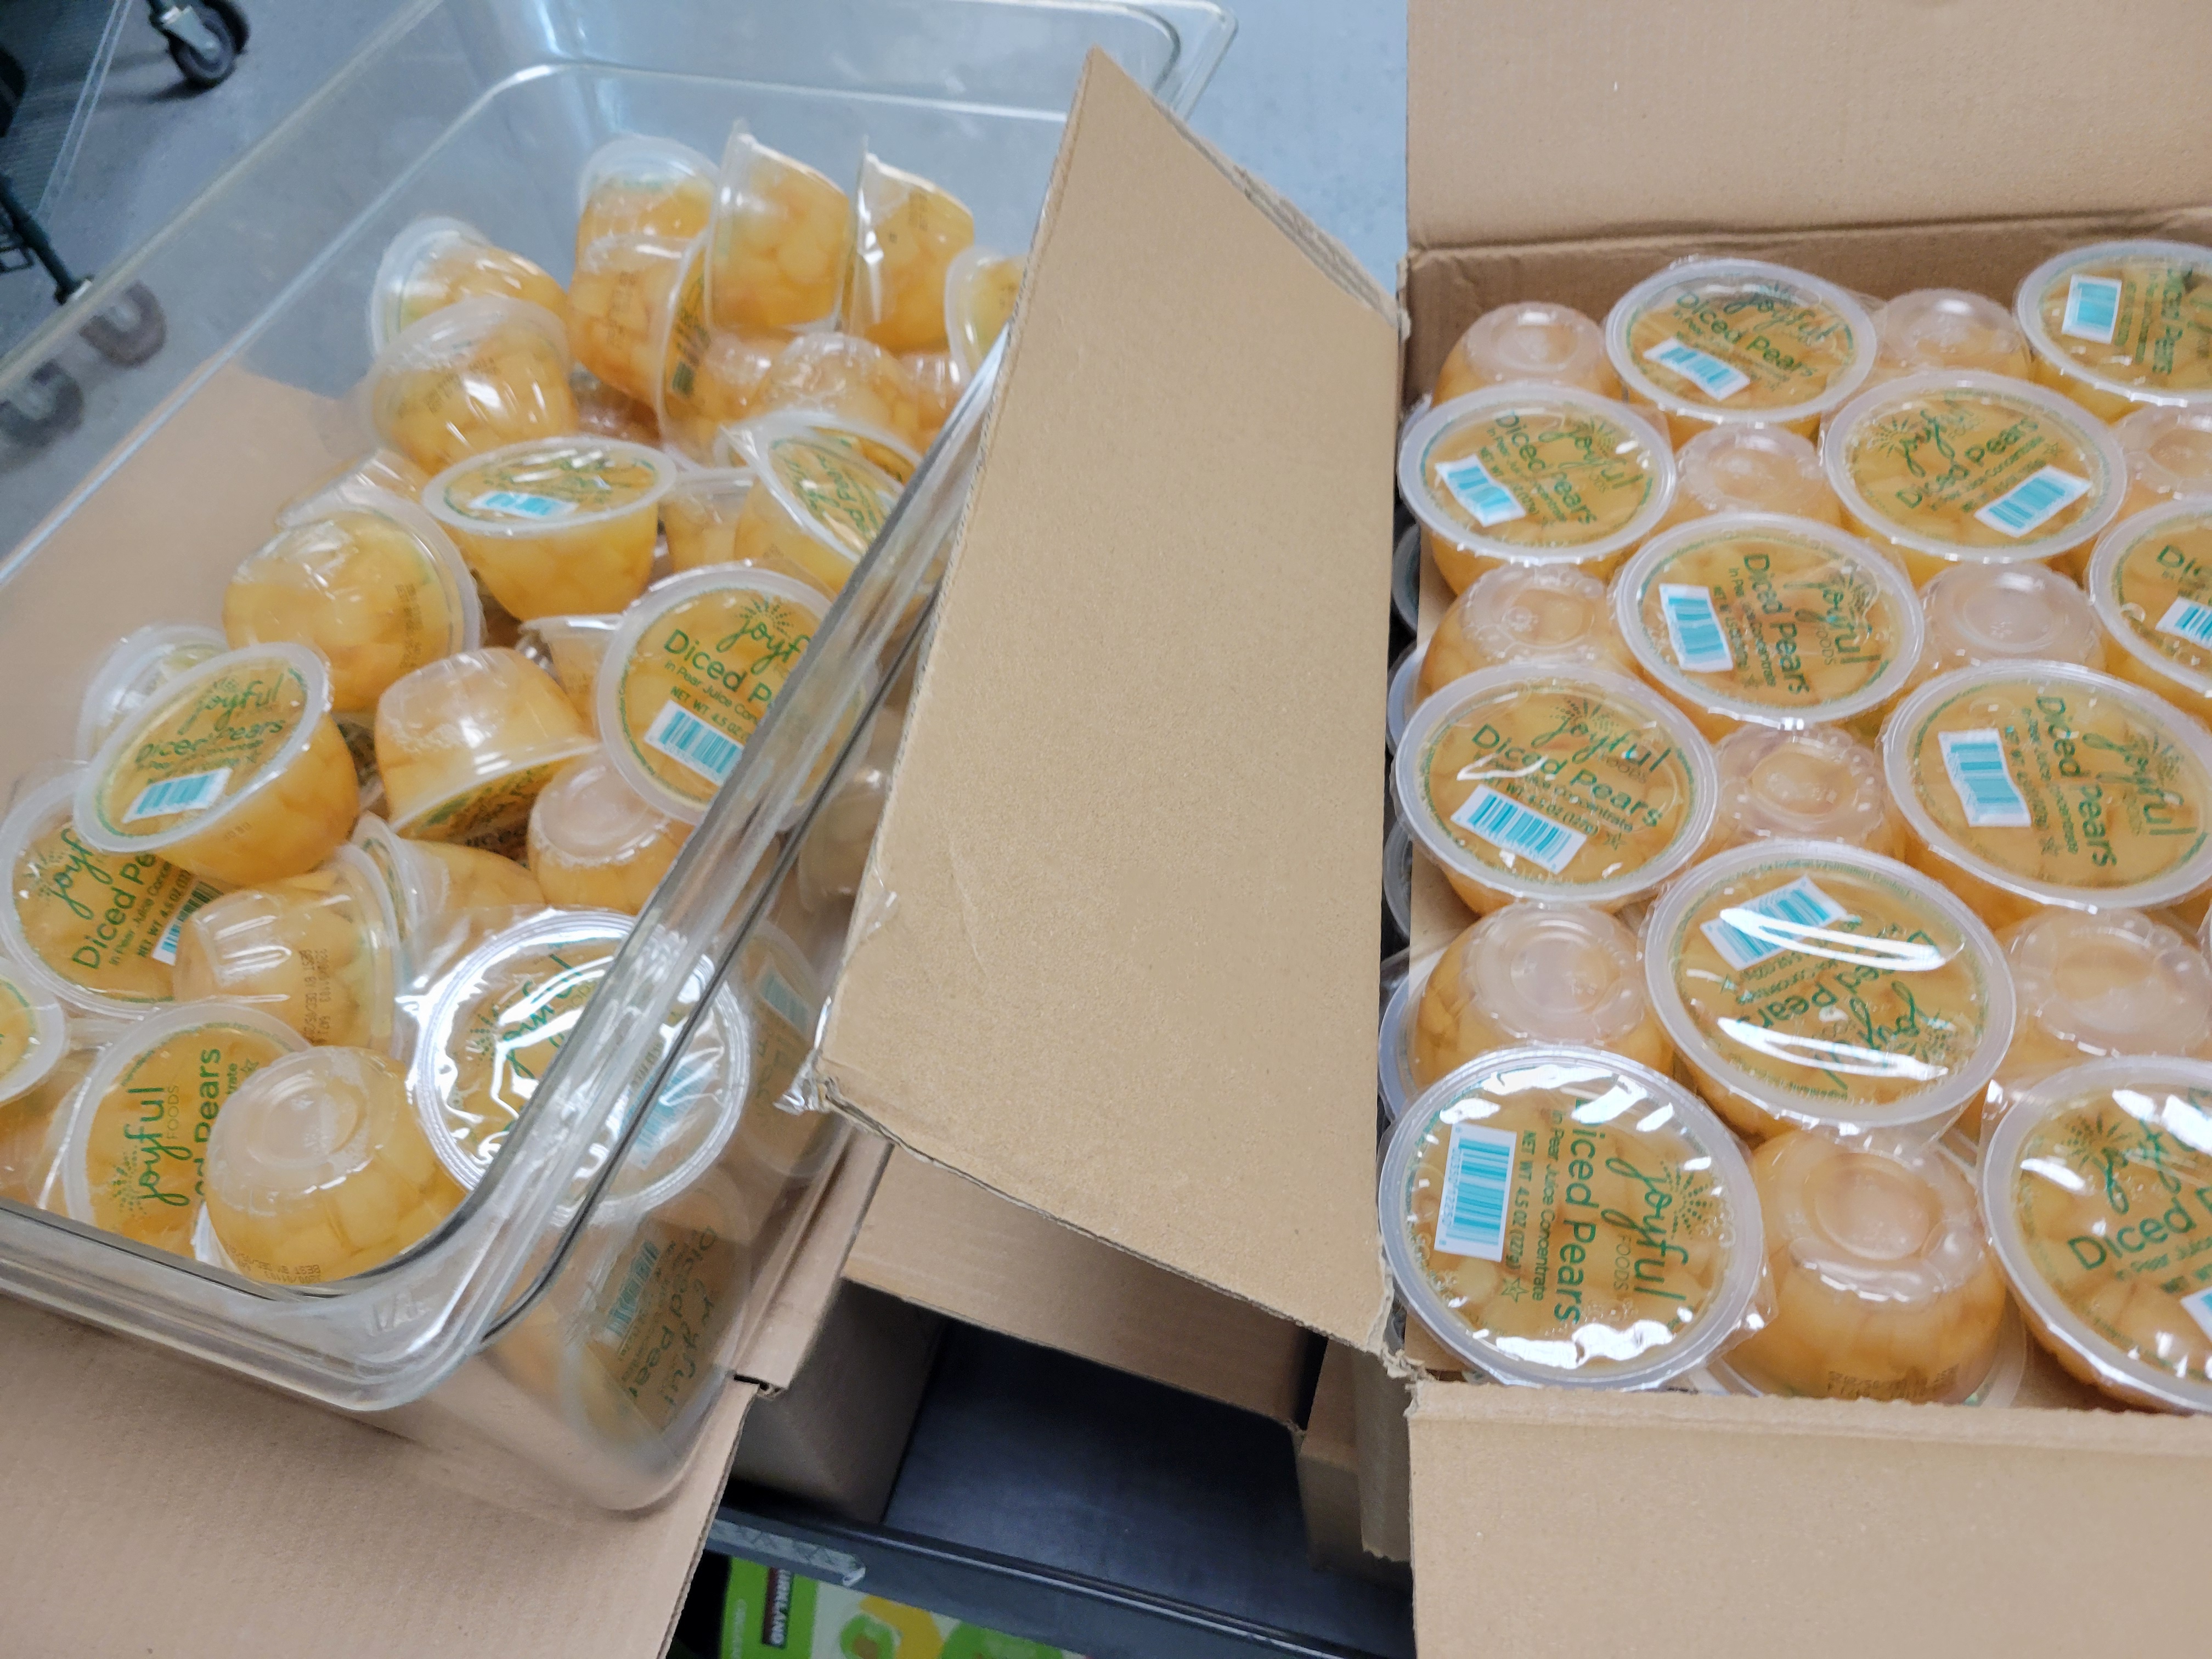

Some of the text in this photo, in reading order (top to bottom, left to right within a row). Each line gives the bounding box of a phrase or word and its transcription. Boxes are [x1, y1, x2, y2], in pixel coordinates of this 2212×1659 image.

[664, 629, 747, 692] Diced
[664, 660, 676, 672] In
[716, 619, 811, 675] joyf
[1770, 622, 1809, 695] Pears
[670, 686, 691, 702] NET
[693, 699, 711, 715] WT
[1472, 724, 1568, 775] Diced
[1570, 769, 1663, 827] Pears
[1531, 718, 1672, 773] joyful
[2036, 697, 2092, 778] Diced
[2071, 784, 2117, 866] Pears
[2082, 733, 2197, 836] joyful
[53, 828, 114, 920] joyf
[72, 887, 136, 969] Diced
[167, 1085, 179, 1139] FOODS
[194, 1049, 222, 1143] Pears
[124, 1087, 193, 1206] joyful
[1521, 1130, 1537, 1154] NET
[1547, 1127, 1565, 1161] Pear
[1532, 1205, 1556, 1302] Concentrate
[1601, 1158, 1689, 1301] joyful
[1613, 1226, 1631, 1291] FOODS
[2068, 1197, 2197, 1271] Diced
[1554, 1219, 1596, 1325] Pears
